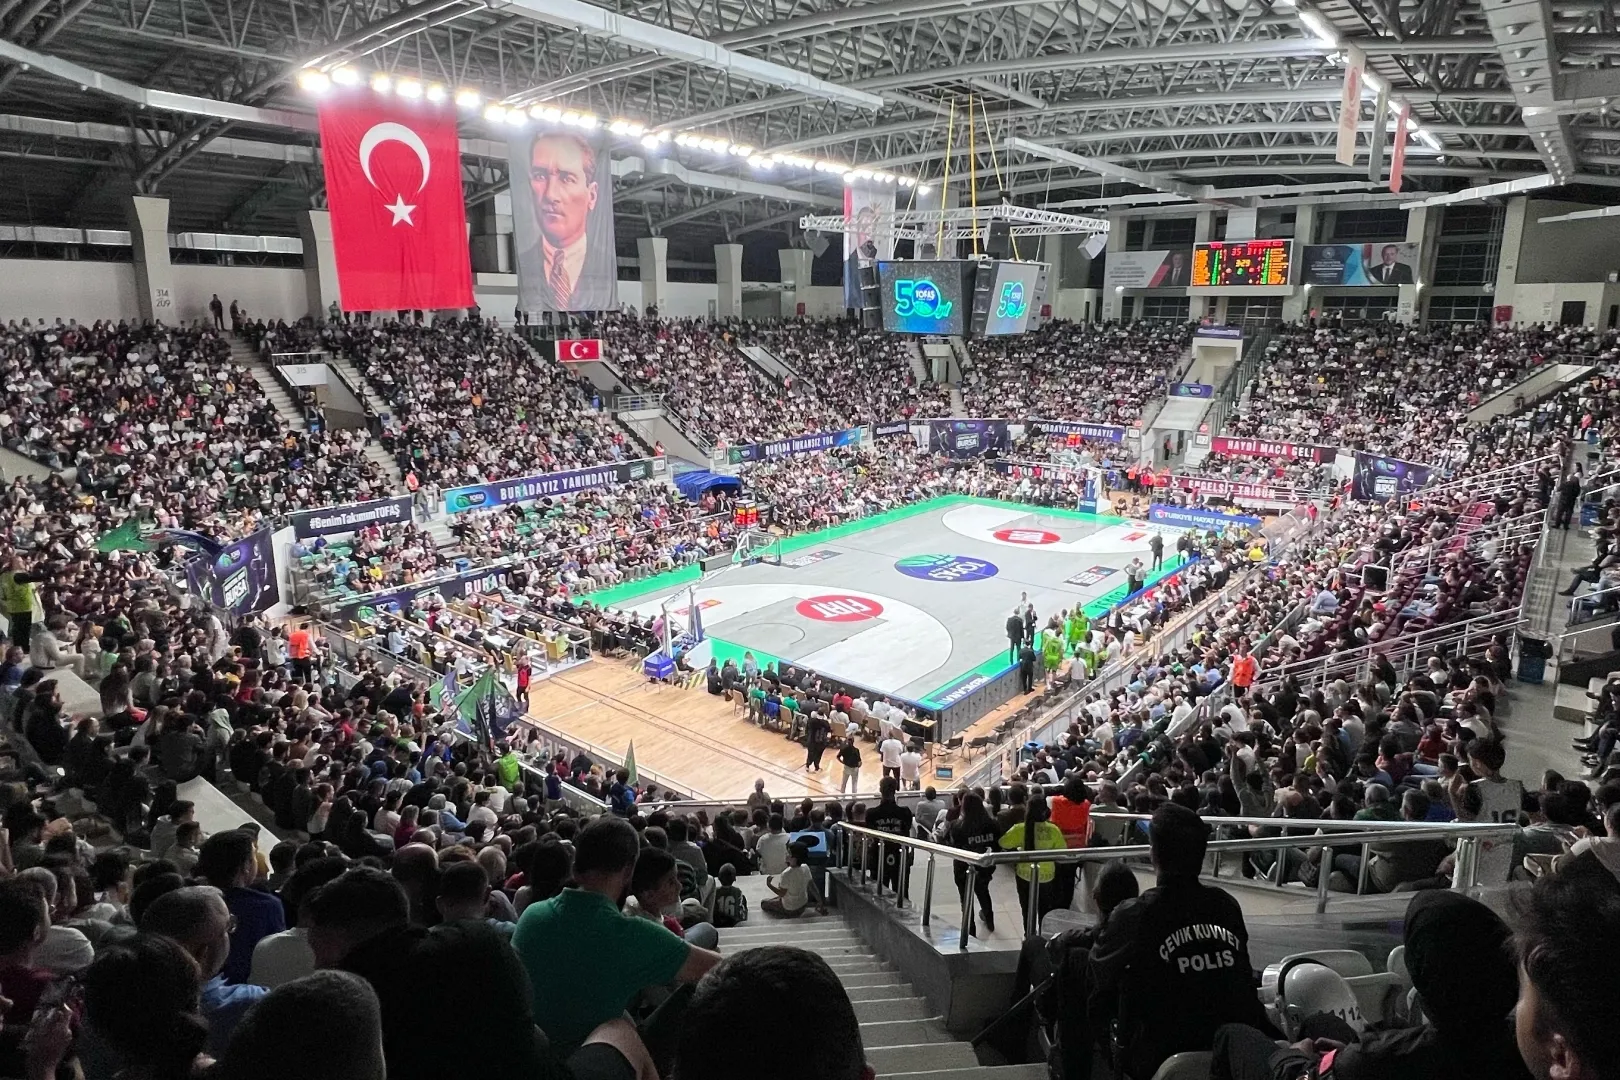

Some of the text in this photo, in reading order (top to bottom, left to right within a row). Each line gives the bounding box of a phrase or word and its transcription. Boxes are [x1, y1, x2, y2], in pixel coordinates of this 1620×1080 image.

[500, 480, 559, 500] BURADAYIZ
[562, 470, 619, 489] YANINDAYIZ
[810, 598, 873, 618] FIAT
[717, 895, 736, 917] 16
[1192, 923, 1240, 951] KUVVET
[1177, 949, 1235, 974] POLİS
